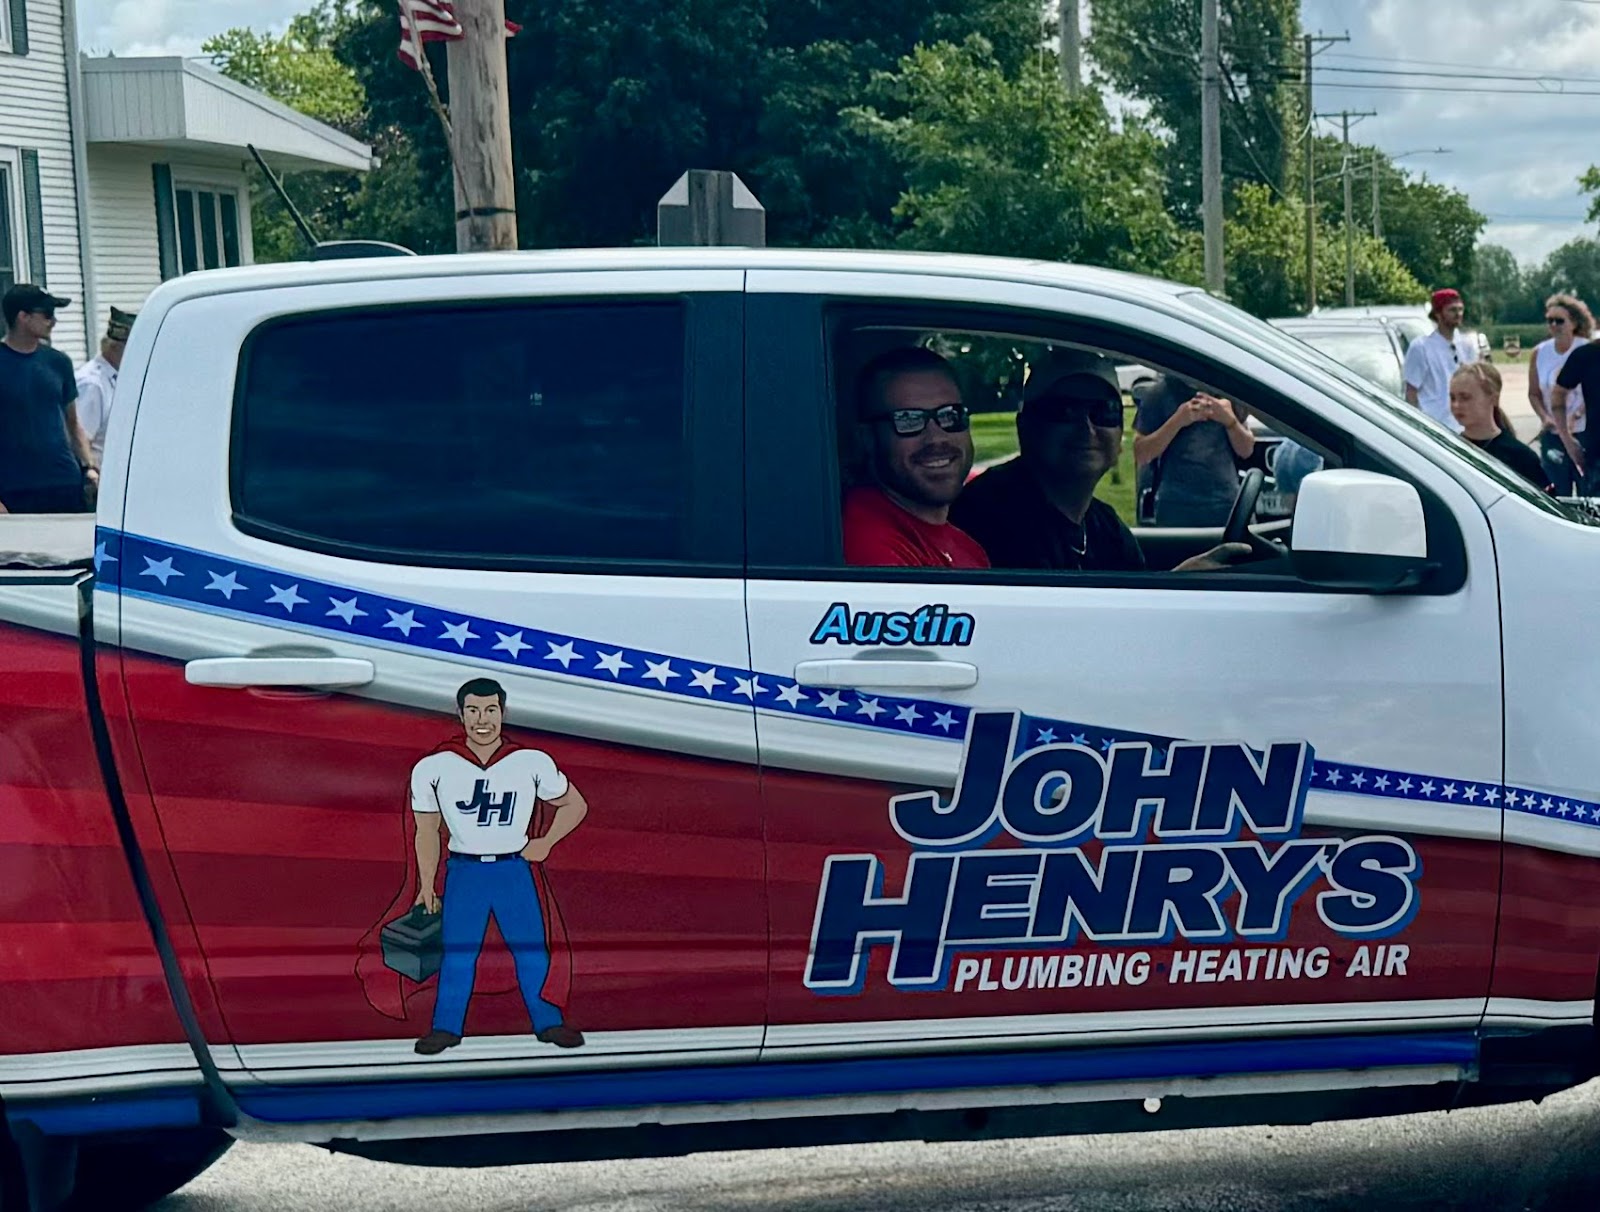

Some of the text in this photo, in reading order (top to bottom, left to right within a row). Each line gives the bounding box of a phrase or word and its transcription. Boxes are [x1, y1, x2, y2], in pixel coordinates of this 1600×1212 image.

[810, 602, 975, 646] Austin
[888, 708, 1312, 846] JOHN
[455, 779, 517, 827] JH
[804, 835, 1418, 989] HENRY'S
[953, 944, 1410, 993] PLUMBING HEATING AIR
